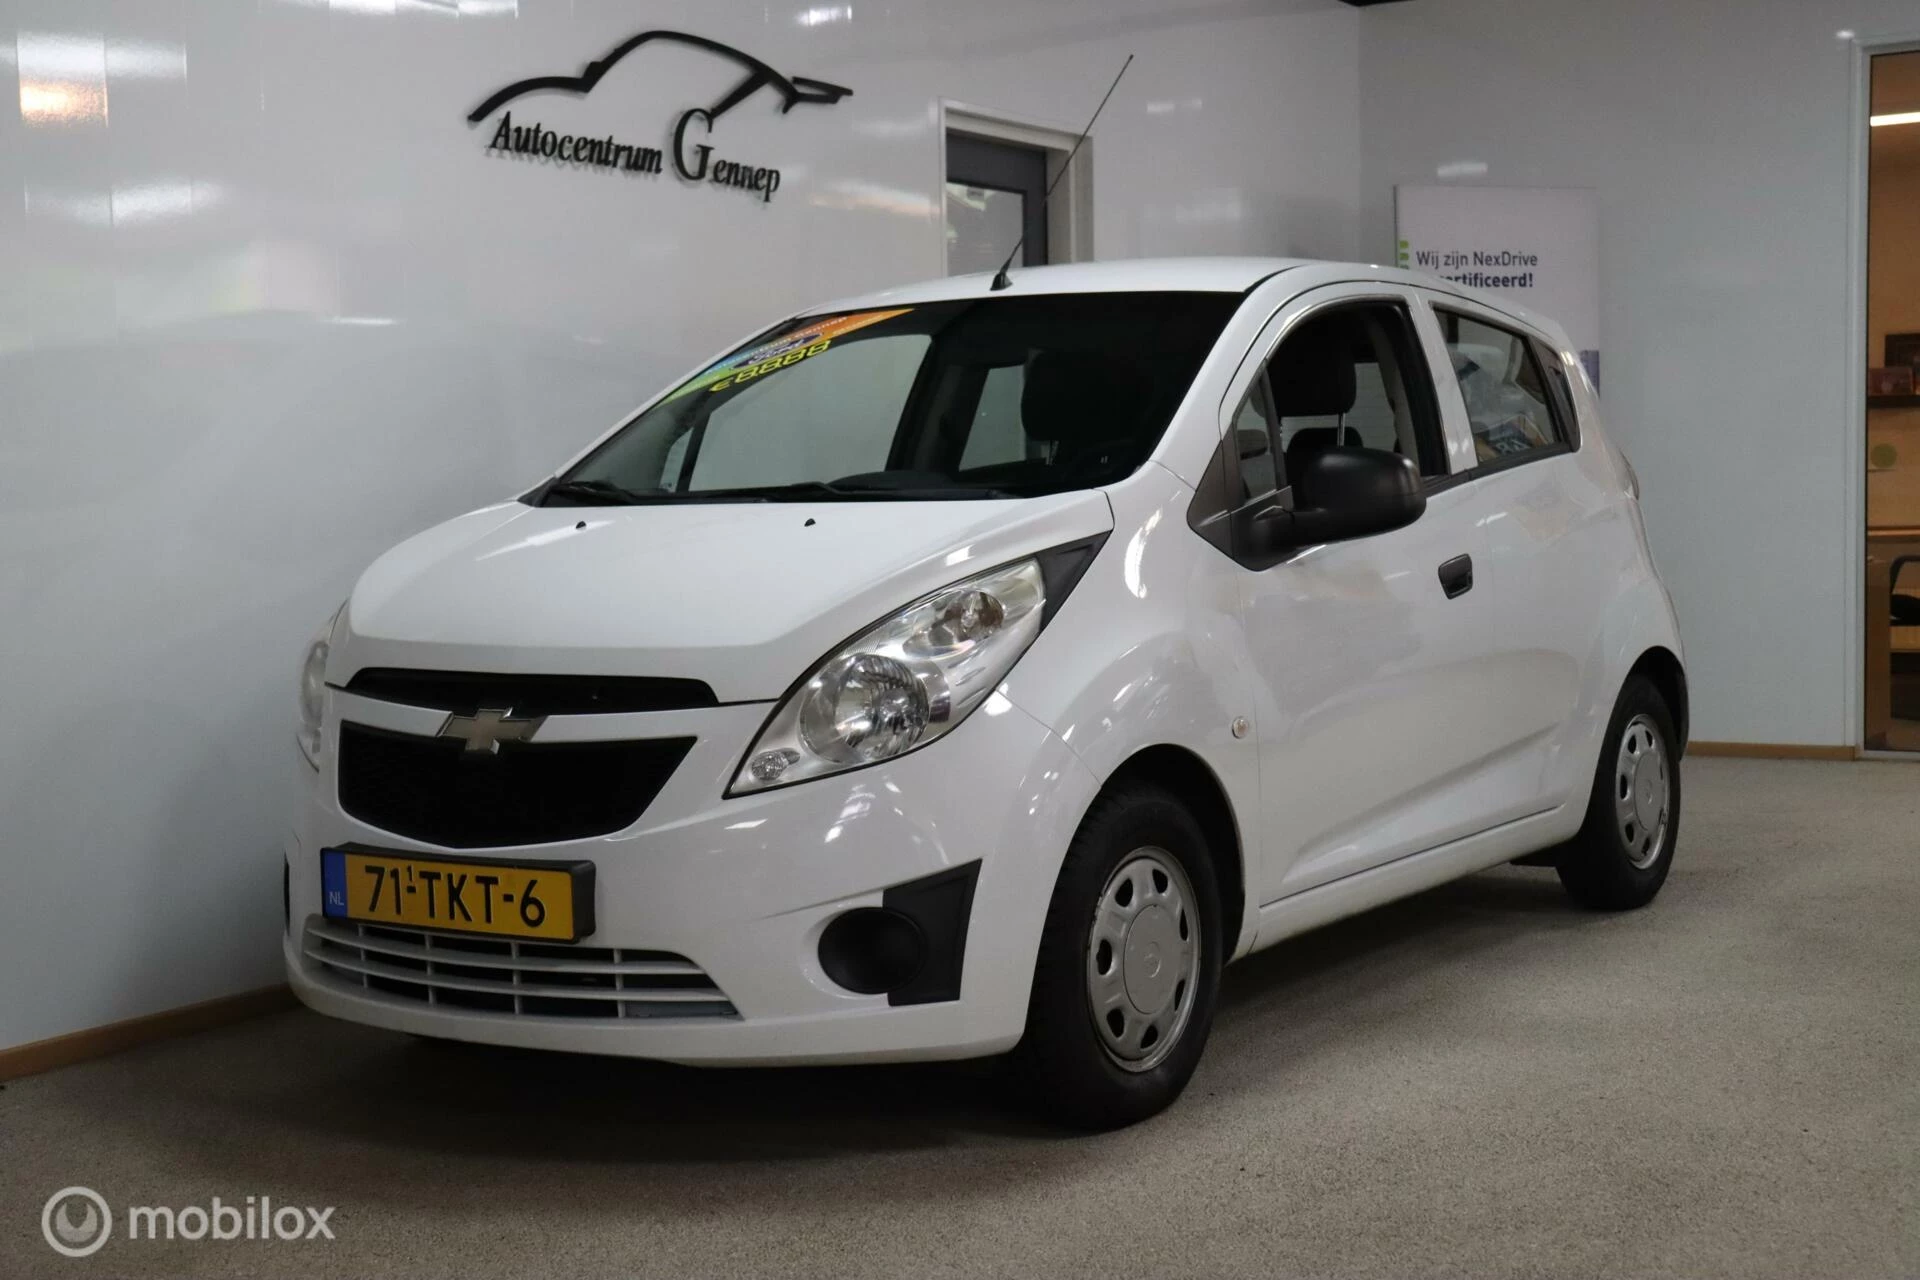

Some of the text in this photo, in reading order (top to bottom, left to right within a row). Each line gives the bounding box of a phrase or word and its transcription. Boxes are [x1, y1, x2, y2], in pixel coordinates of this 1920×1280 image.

[490, 108, 781, 201] Autocentrum Gennep
[1416, 251, 1538, 269] Wij zijn NexDrive
[1440, 273, 1533, 288] rtificeerd!
[329, 892, 345, 906] NL
